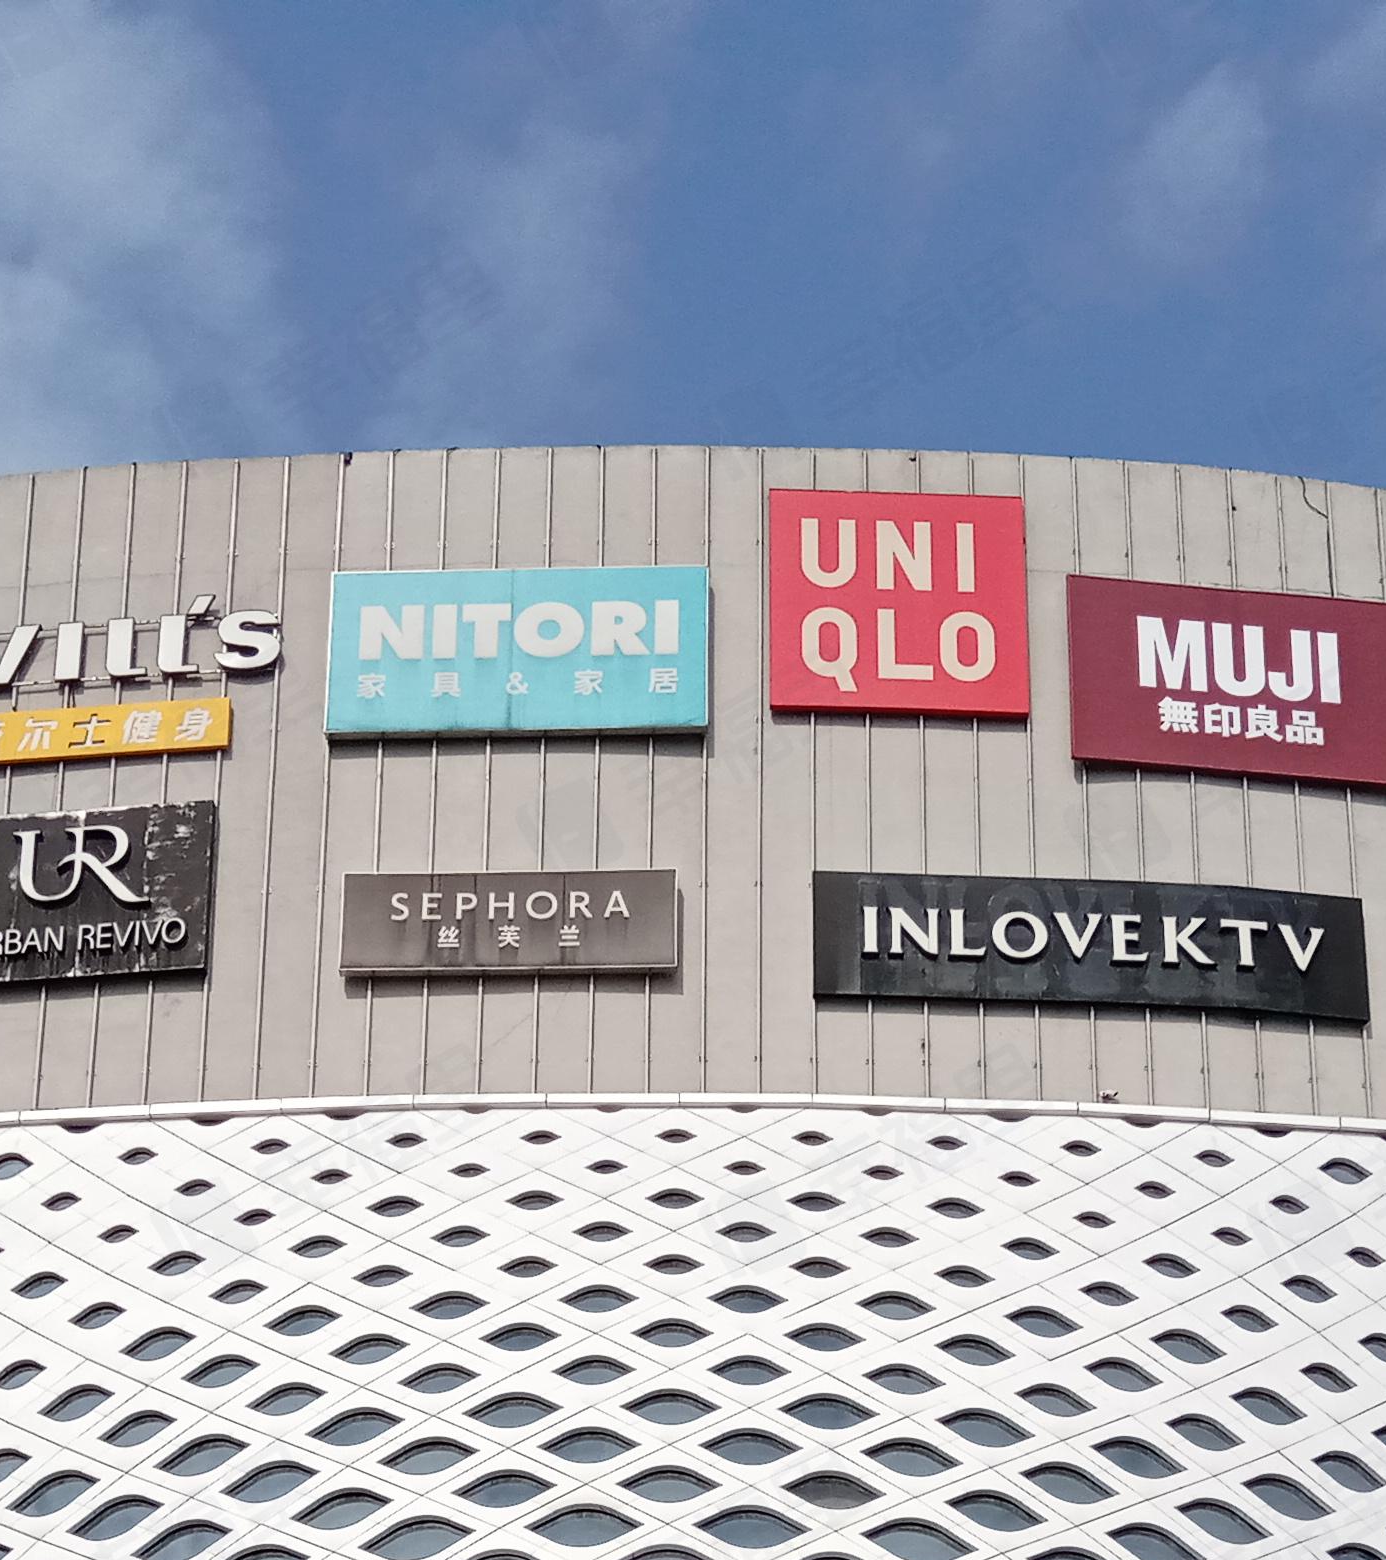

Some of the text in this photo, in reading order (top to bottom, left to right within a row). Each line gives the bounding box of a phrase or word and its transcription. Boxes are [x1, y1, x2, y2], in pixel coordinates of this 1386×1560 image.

[799, 516, 976, 594] UNI
[358, 599, 680, 661] NITORI
[799, 605, 997, 693] QLO
[1135, 614, 1343, 705] MUJI
[1158, 696, 1324, 746] 無印良品
[13, 824, 152, 903] UR
[77, 915, 187, 951] REVIVO
[390, 890, 631, 921] SEPHORA
[436, 925, 581, 949] 丝芙兰
